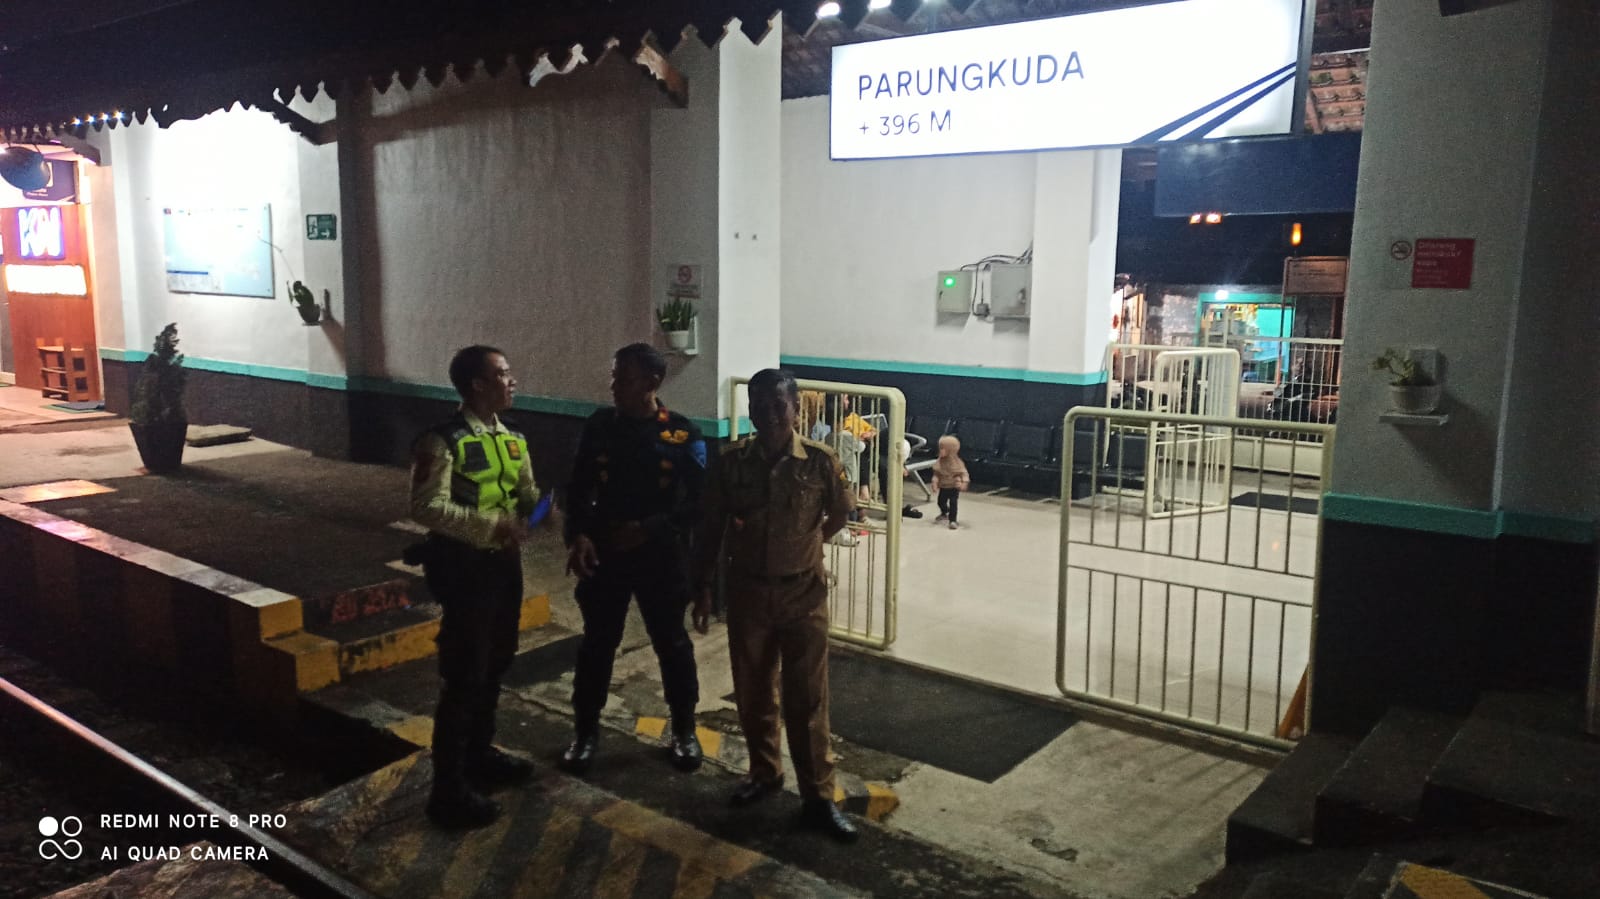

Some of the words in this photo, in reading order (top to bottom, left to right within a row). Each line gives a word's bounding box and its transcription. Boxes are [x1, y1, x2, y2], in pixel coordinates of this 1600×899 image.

[858, 51, 1085, 101] PARUNGKUDA
[879, 113, 920, 136] 396
[930, 109, 951, 132] M
